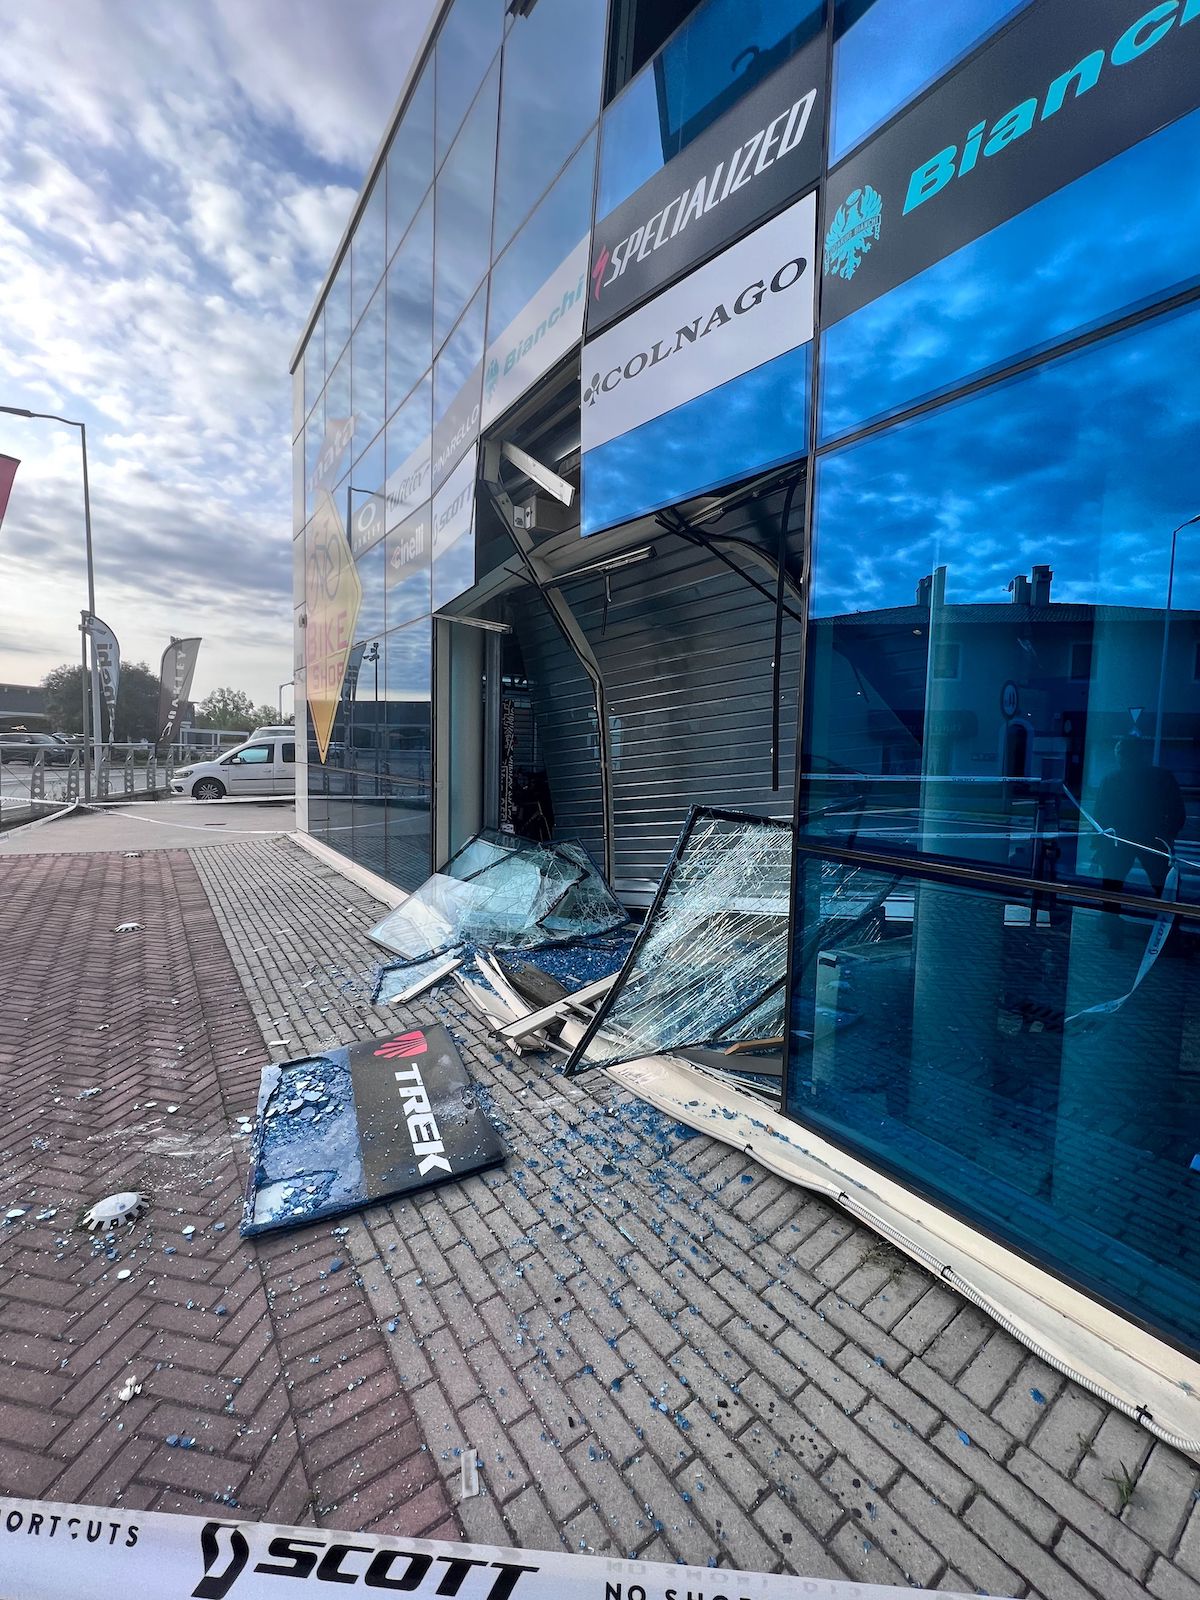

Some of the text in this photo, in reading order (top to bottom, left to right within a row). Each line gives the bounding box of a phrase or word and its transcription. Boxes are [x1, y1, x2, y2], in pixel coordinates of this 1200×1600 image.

[902, 0, 1200, 217] Bianc
[603, 88, 818, 288] SPECIALIZED
[503, 276, 585, 377] Bianchi
[599, 257, 808, 393] COLNAGO
[432, 404, 480, 475] PINARELLO
[306, 610, 348, 665] BIKE
[312, 661, 345, 690] SHOP
[395, 1063, 453, 1176] TREK
[0, 1509, 139, 1548] ORTCUTS
[253, 1537, 540, 1600] SCOTT
